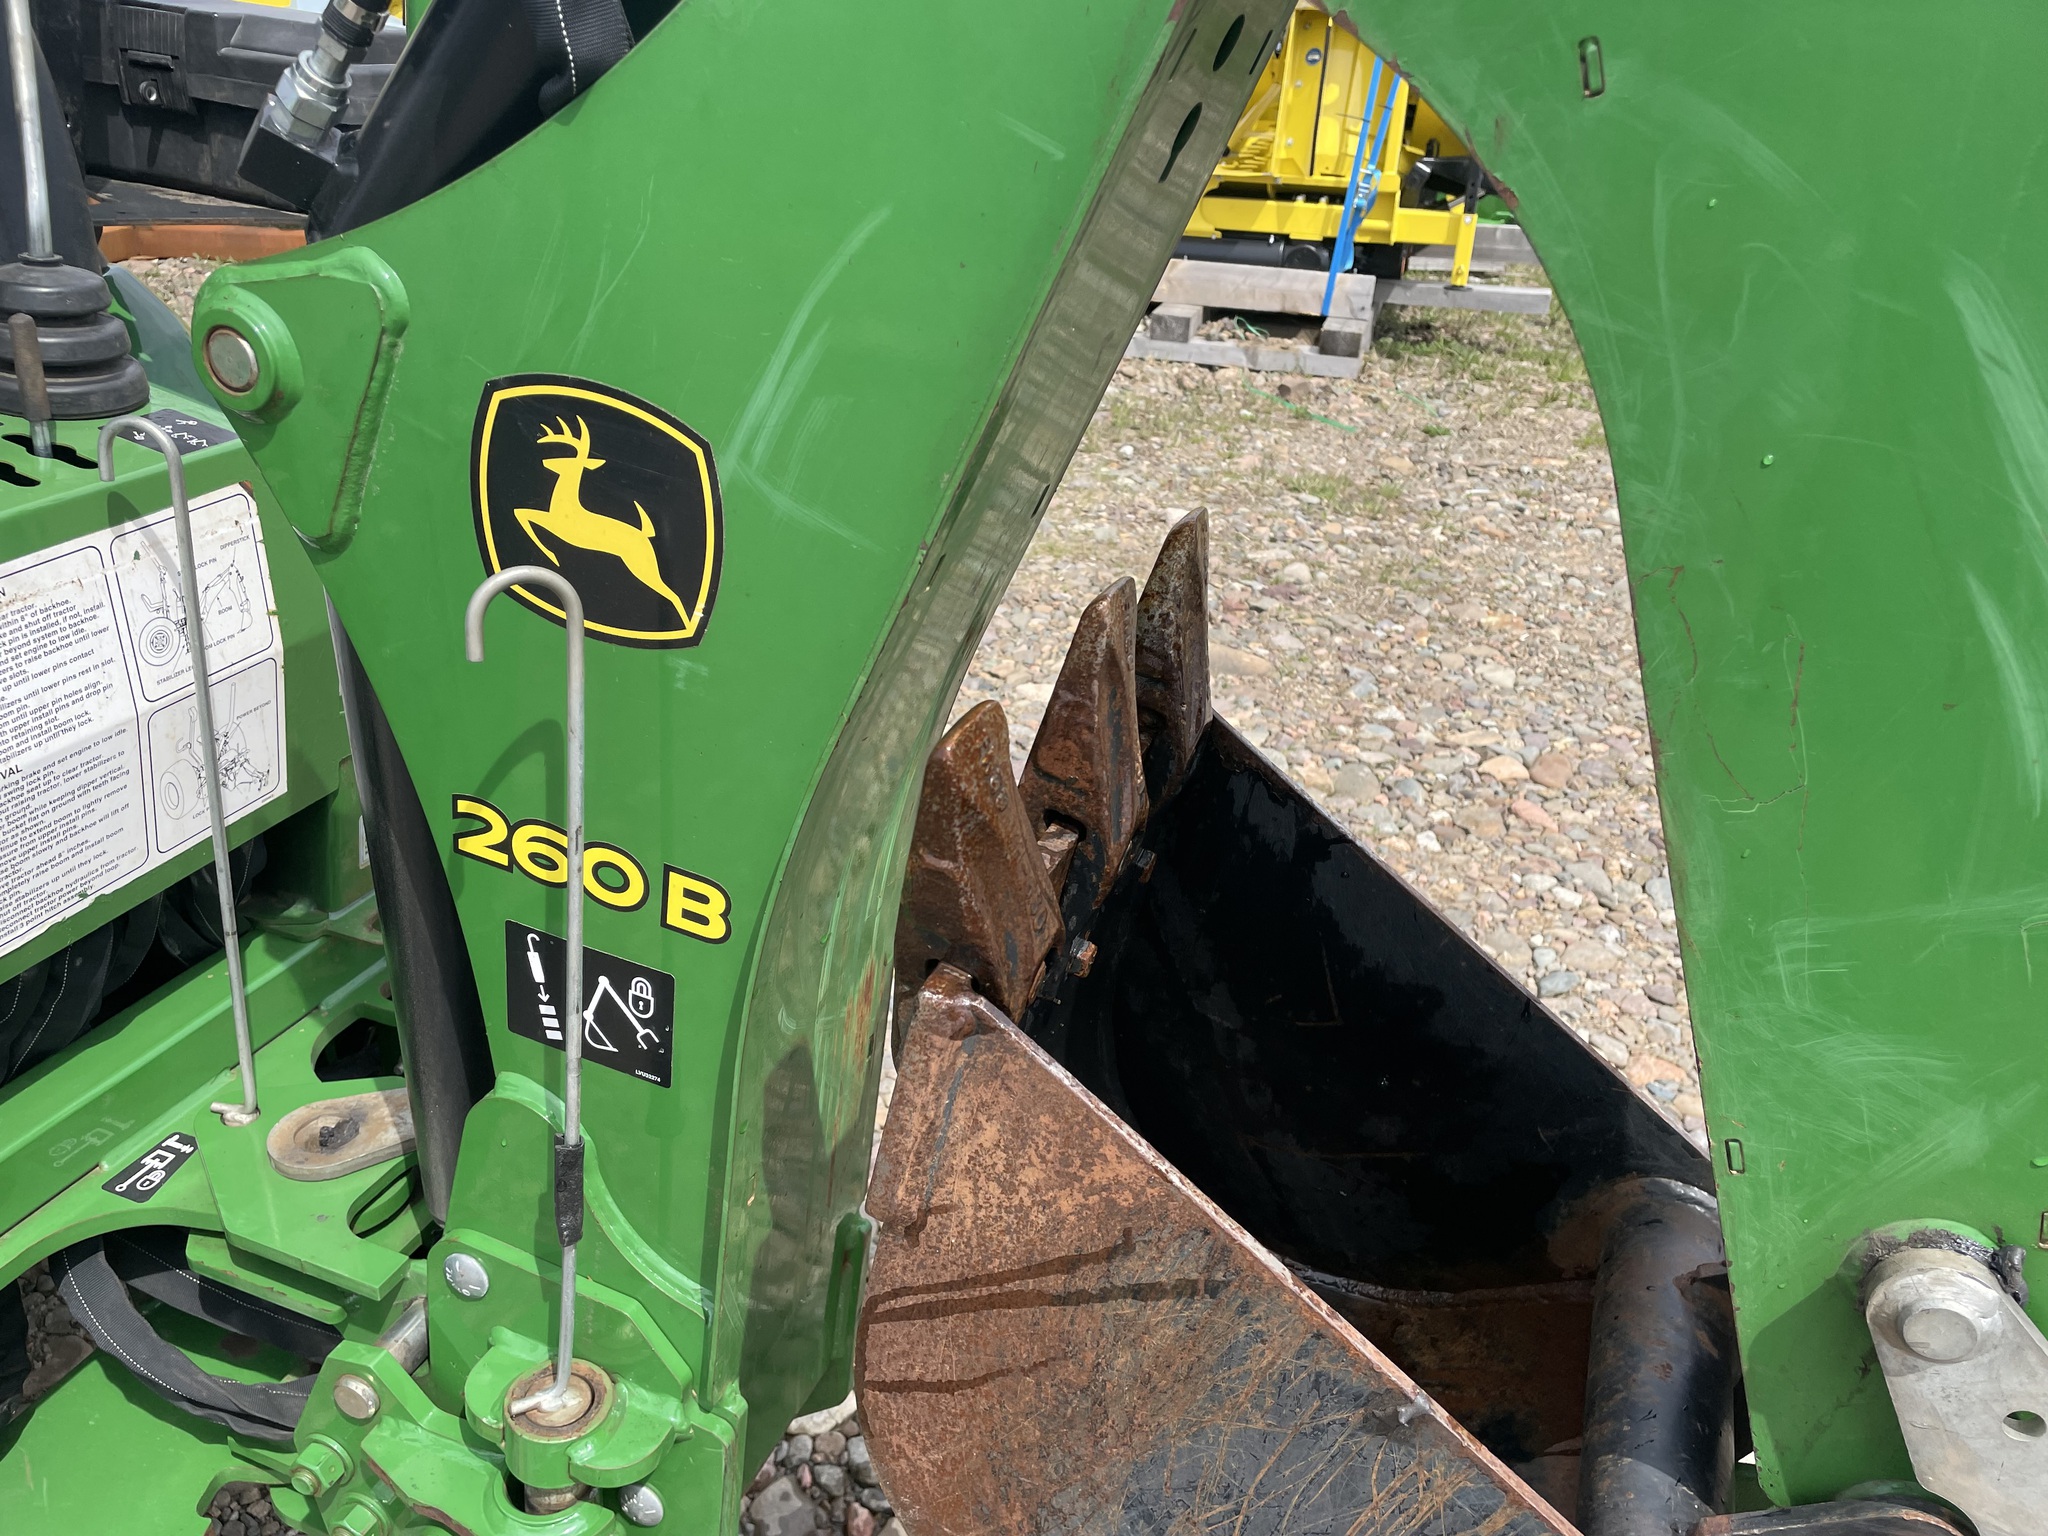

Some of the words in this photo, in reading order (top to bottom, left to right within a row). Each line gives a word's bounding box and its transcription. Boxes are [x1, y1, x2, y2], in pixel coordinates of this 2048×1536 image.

[220, 535, 250, 550] DIPPERSTICK
[209, 557, 217, 565] PIN
[9, 625, 22, 635] and
[24, 618, 41, 629] shut
[42, 613, 52, 622] off
[53, 605, 76, 618] tractor
[30, 610, 38, 618] of
[218, 606, 233, 616] BOOM
[4, 639, 31, 655] beyond
[33, 630, 58, 644] system
[8, 636, 20, 646] pin
[11, 652, 22, 662] set
[24, 643, 48, 656] engine
[58, 634, 70, 642] low
[24, 654, 42, 665] raise
[43, 641, 73, 657] backhoe
[74, 633, 90, 644] until
[91, 626, 109, 637] lower
[213, 637, 227, 647] LOCK
[227, 633, 236, 641] PIN
[2, 684, 12, 692] up
[14, 675, 30, 687] until
[31, 668, 50, 680] lower
[52, 661, 68, 672] pins
[69, 649, 94, 664] contact
[157, 668, 185, 686] STABILIZER
[24, 689, 40, 700] until
[41, 681, 60, 693] lower
[62, 674, 77, 686] pins
[78, 667, 92, 677] rest
[9, 720, 30, 733] upper
[32, 708, 53, 723] install
[55, 702, 70, 714] pins
[72, 695, 84, 705] and
[85, 688, 101, 699] drop
[102, 683, 113, 693] pin
[11, 711, 28, 724] until
[29, 703, 49, 716] upper
[51, 697, 61, 707] pin
[64, 688, 83, 700] holes
[237, 709, 253, 720] POWER
[253, 700, 271, 713] BEYOND
[11, 723, 43, 741] retaining
[16, 737, 29, 748] and
[30, 726, 52, 741] install
[53, 718, 73, 730] boom
[34, 740, 43, 748] up
[44, 731, 60, 743] until
[61, 725, 76, 735] they
[453, 794, 649, 912] 260
[661, 863, 731, 944] B
